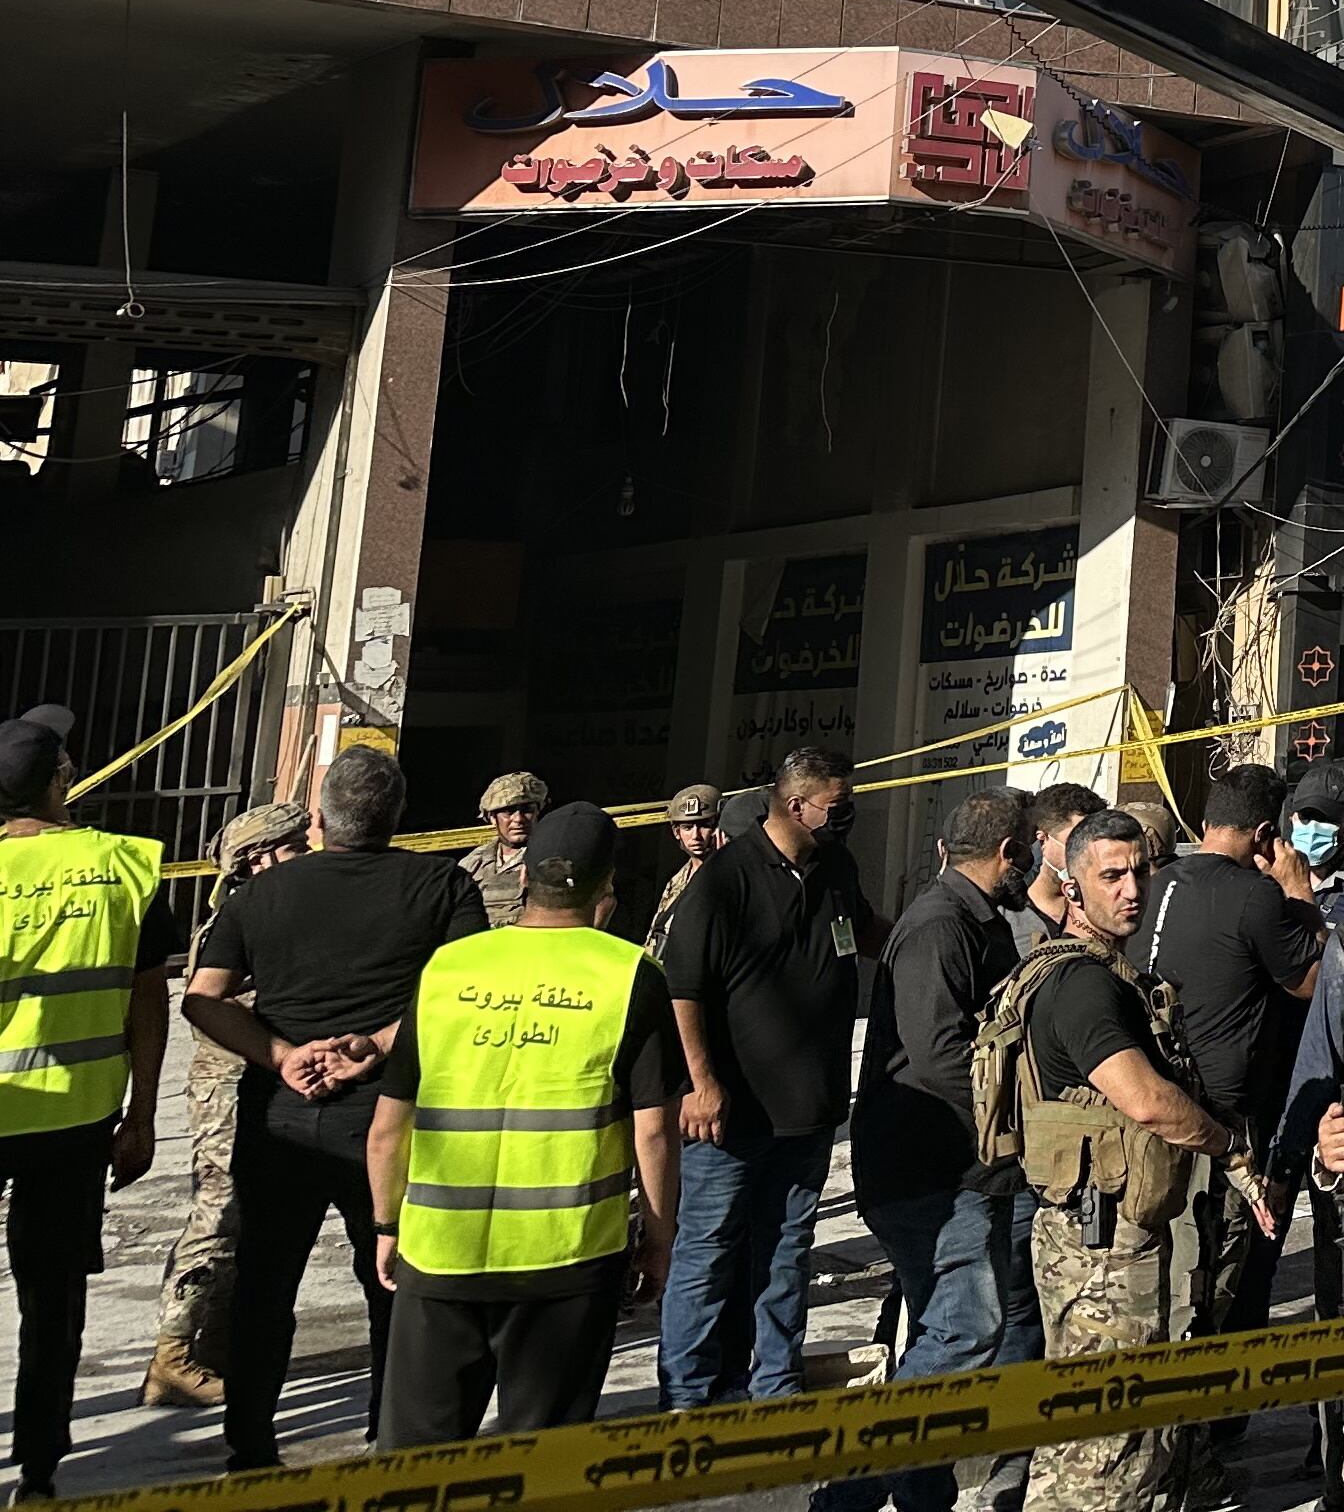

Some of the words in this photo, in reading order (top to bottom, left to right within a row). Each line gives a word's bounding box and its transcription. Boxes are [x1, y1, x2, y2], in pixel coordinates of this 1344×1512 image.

[1040, 665, 1067, 682] عدة
[62, 868, 122, 887] منطقة
[457, 984, 523, 1012] بيروت
[531, 982, 594, 1012] منطقة
[472, 1019, 560, 1050] الطوارئ
